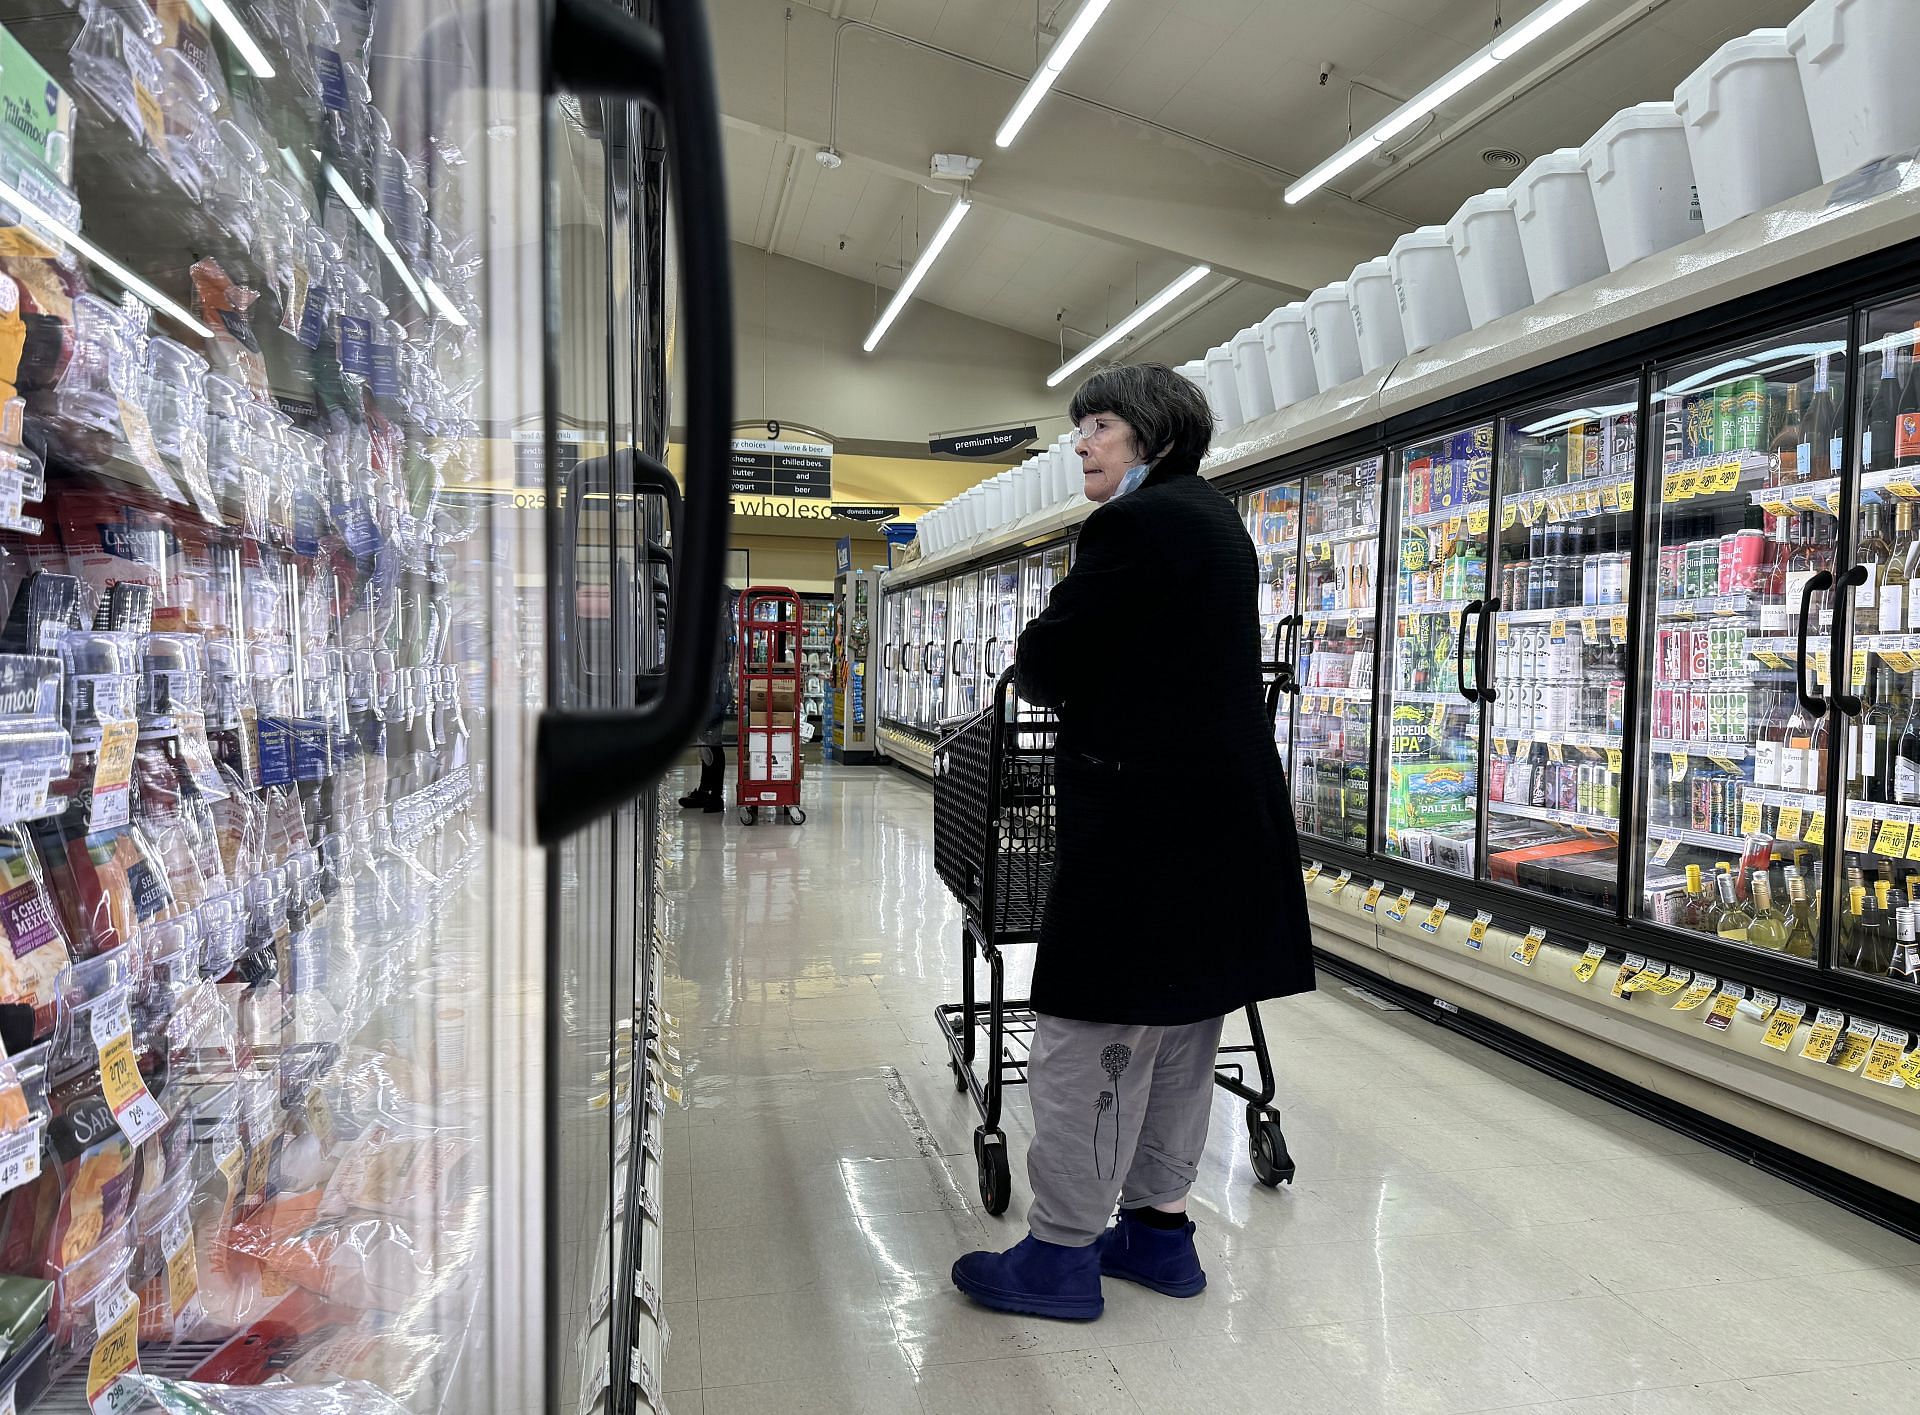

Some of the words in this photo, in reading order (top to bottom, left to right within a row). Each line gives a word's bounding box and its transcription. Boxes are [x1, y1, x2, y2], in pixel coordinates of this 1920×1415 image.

[1722, 420, 1736, 429] PA
[1738, 415, 1764, 425] PALE
[767, 420, 780, 440] 9
[1739, 424, 1761, 432] ALE
[740, 441, 767, 449] choices
[955, 437, 993, 451] premium
[993, 435, 1013, 444] beer
[731, 455, 756, 464] cheese
[781, 458, 805, 466] chilled
[805, 460, 824, 468] bevs.
[732, 469, 755, 477] butter
[795, 472, 810, 480] and
[731, 483, 755, 491] yogurt
[794, 485, 811, 493] beer
[740, 496, 833, 519] wholeso
[1395, 736, 1420, 752] IPA
[1756, 757, 1774, 766] ECOY
[1421, 804, 1447, 814] PALE
[141, 871, 158, 889] SHA
[140, 885, 168, 906] CHED
[11, 909, 20, 921] 4
[16, 909, 50, 937] MEXIC
[128, 1105, 144, 1127] 299
[73, 1106, 115, 1144] SAR
[1, 1162, 19, 1184] 499
[106, 1383, 124, 1411] 299
